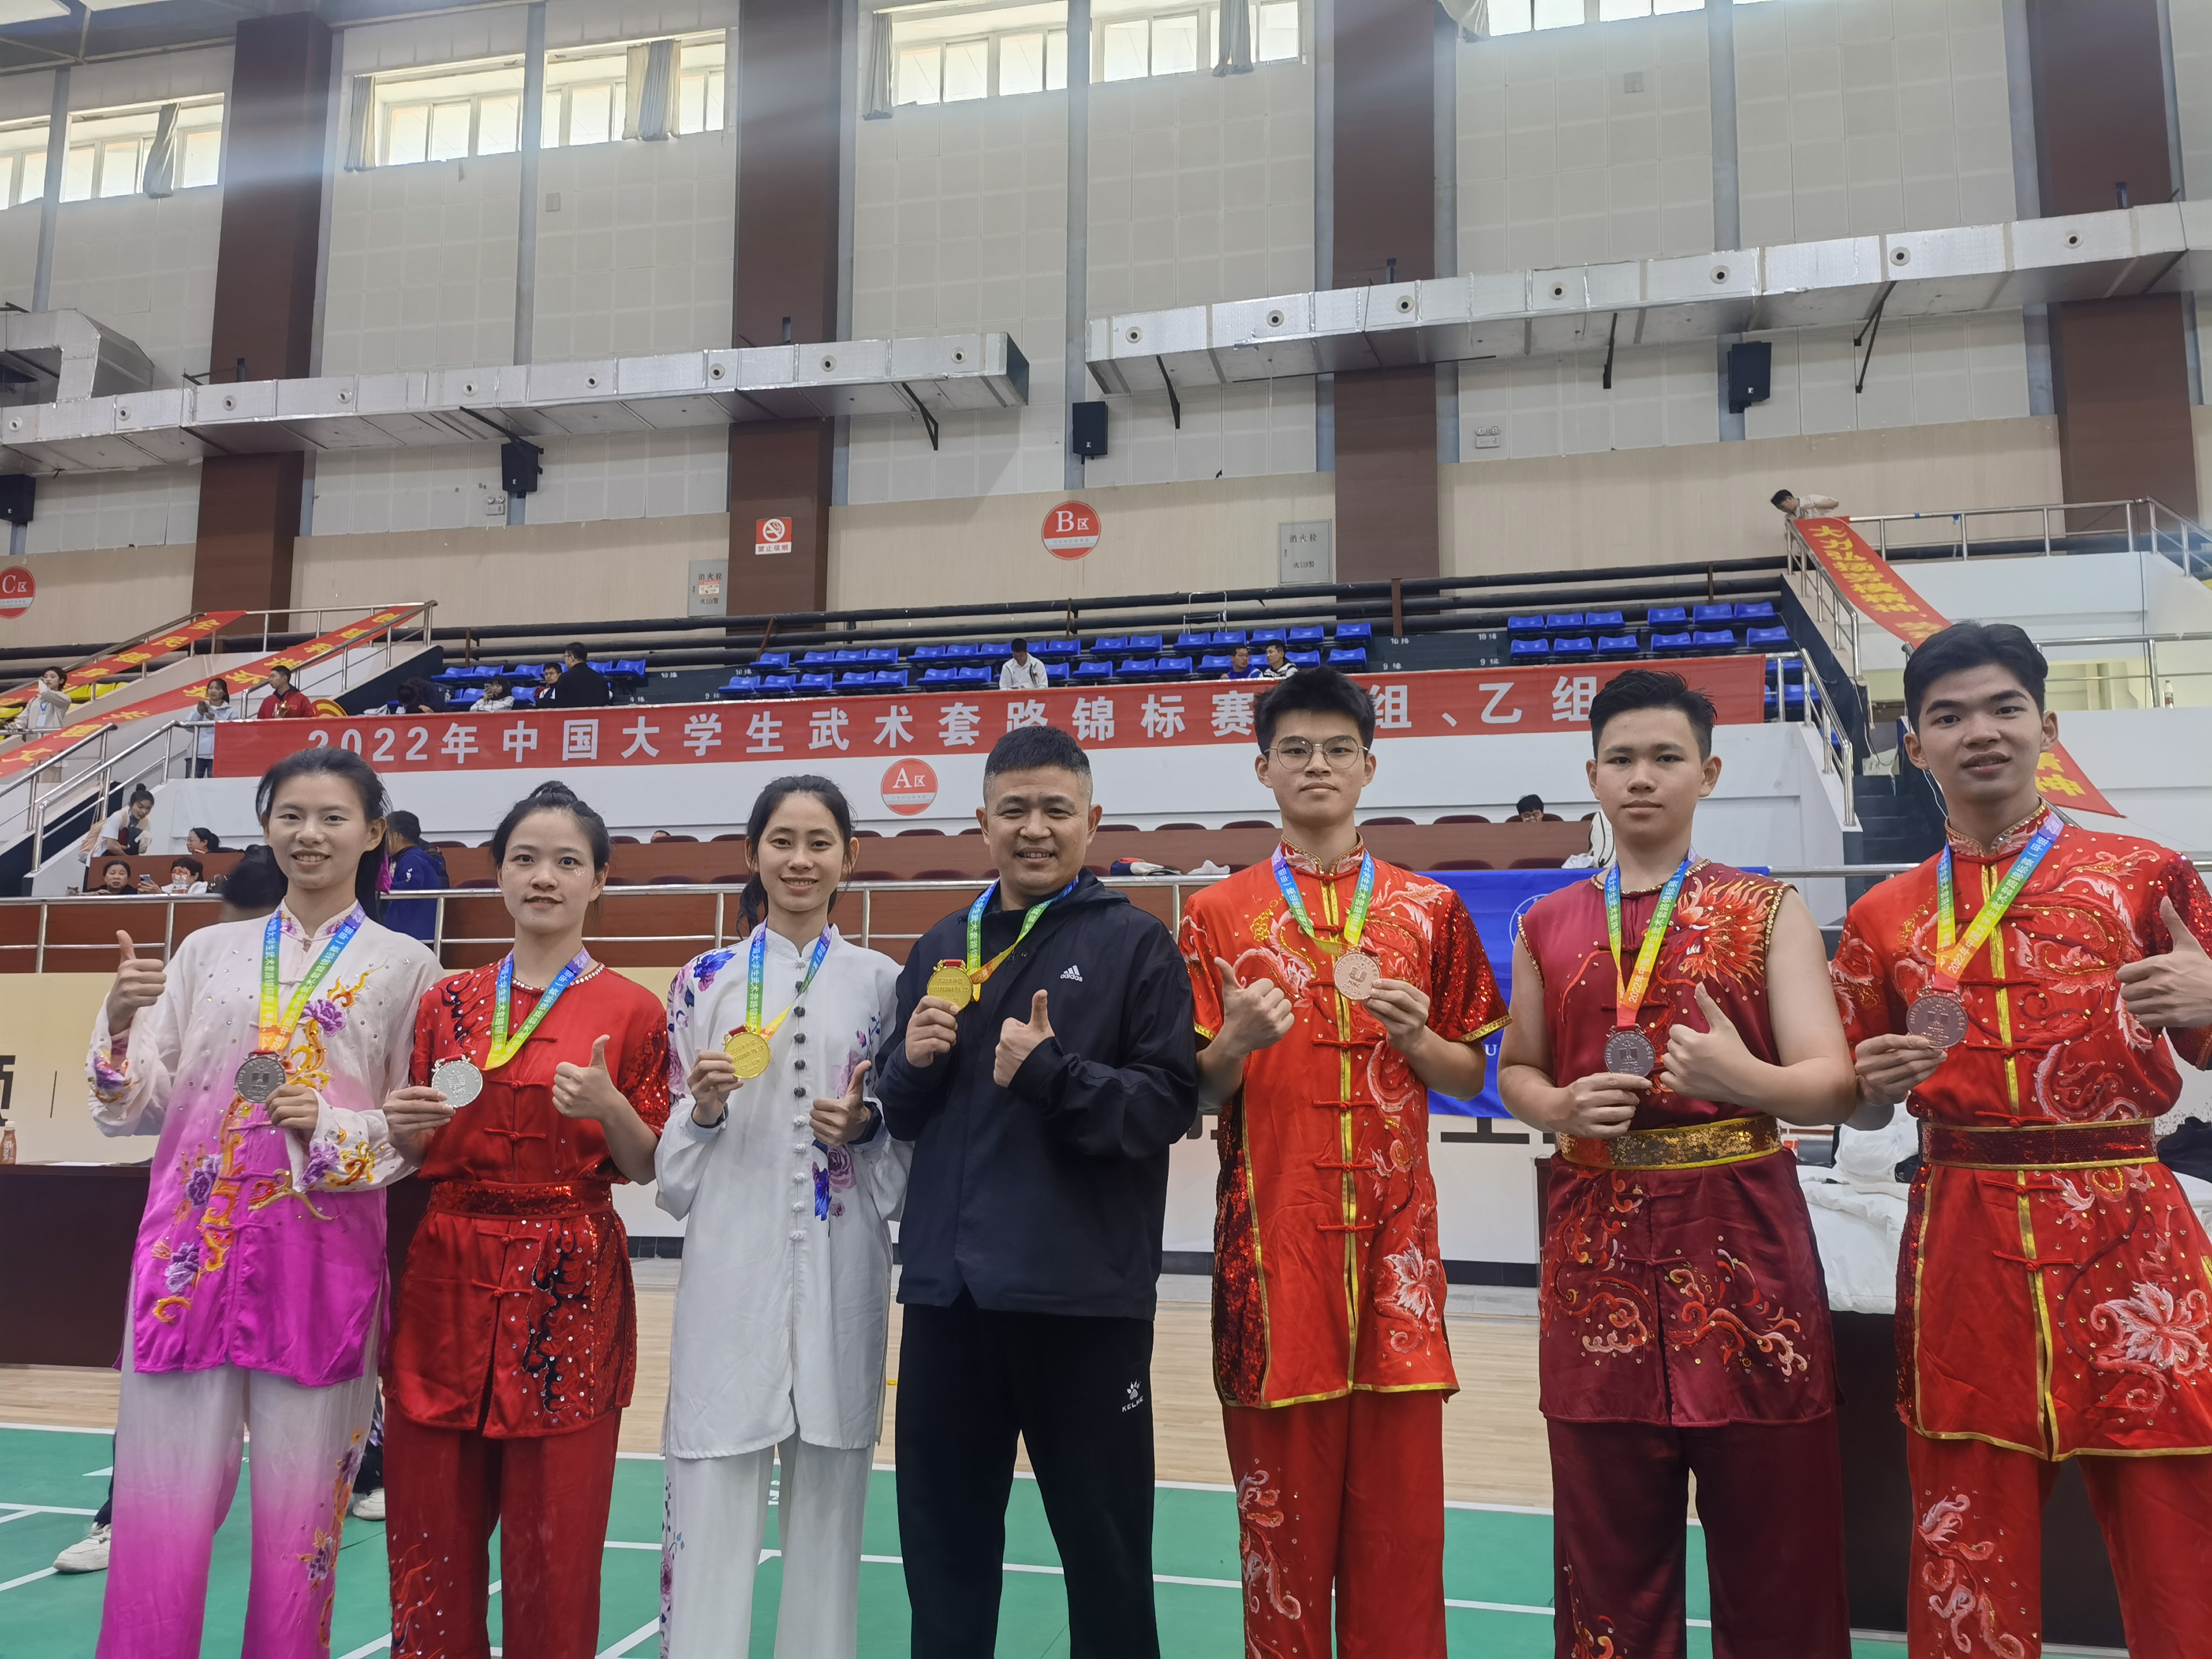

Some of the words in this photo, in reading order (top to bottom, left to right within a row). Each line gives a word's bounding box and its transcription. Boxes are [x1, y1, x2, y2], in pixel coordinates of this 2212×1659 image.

[1056, 510, 1089, 532] B区
[1289, 532, 1318, 543] 消火栓
[698, 572, 722, 581] 消火栓
[2, 575, 28, 594] C区
[892, 767, 926, 788] A区
[1060, 972, 1083, 982] adidas
